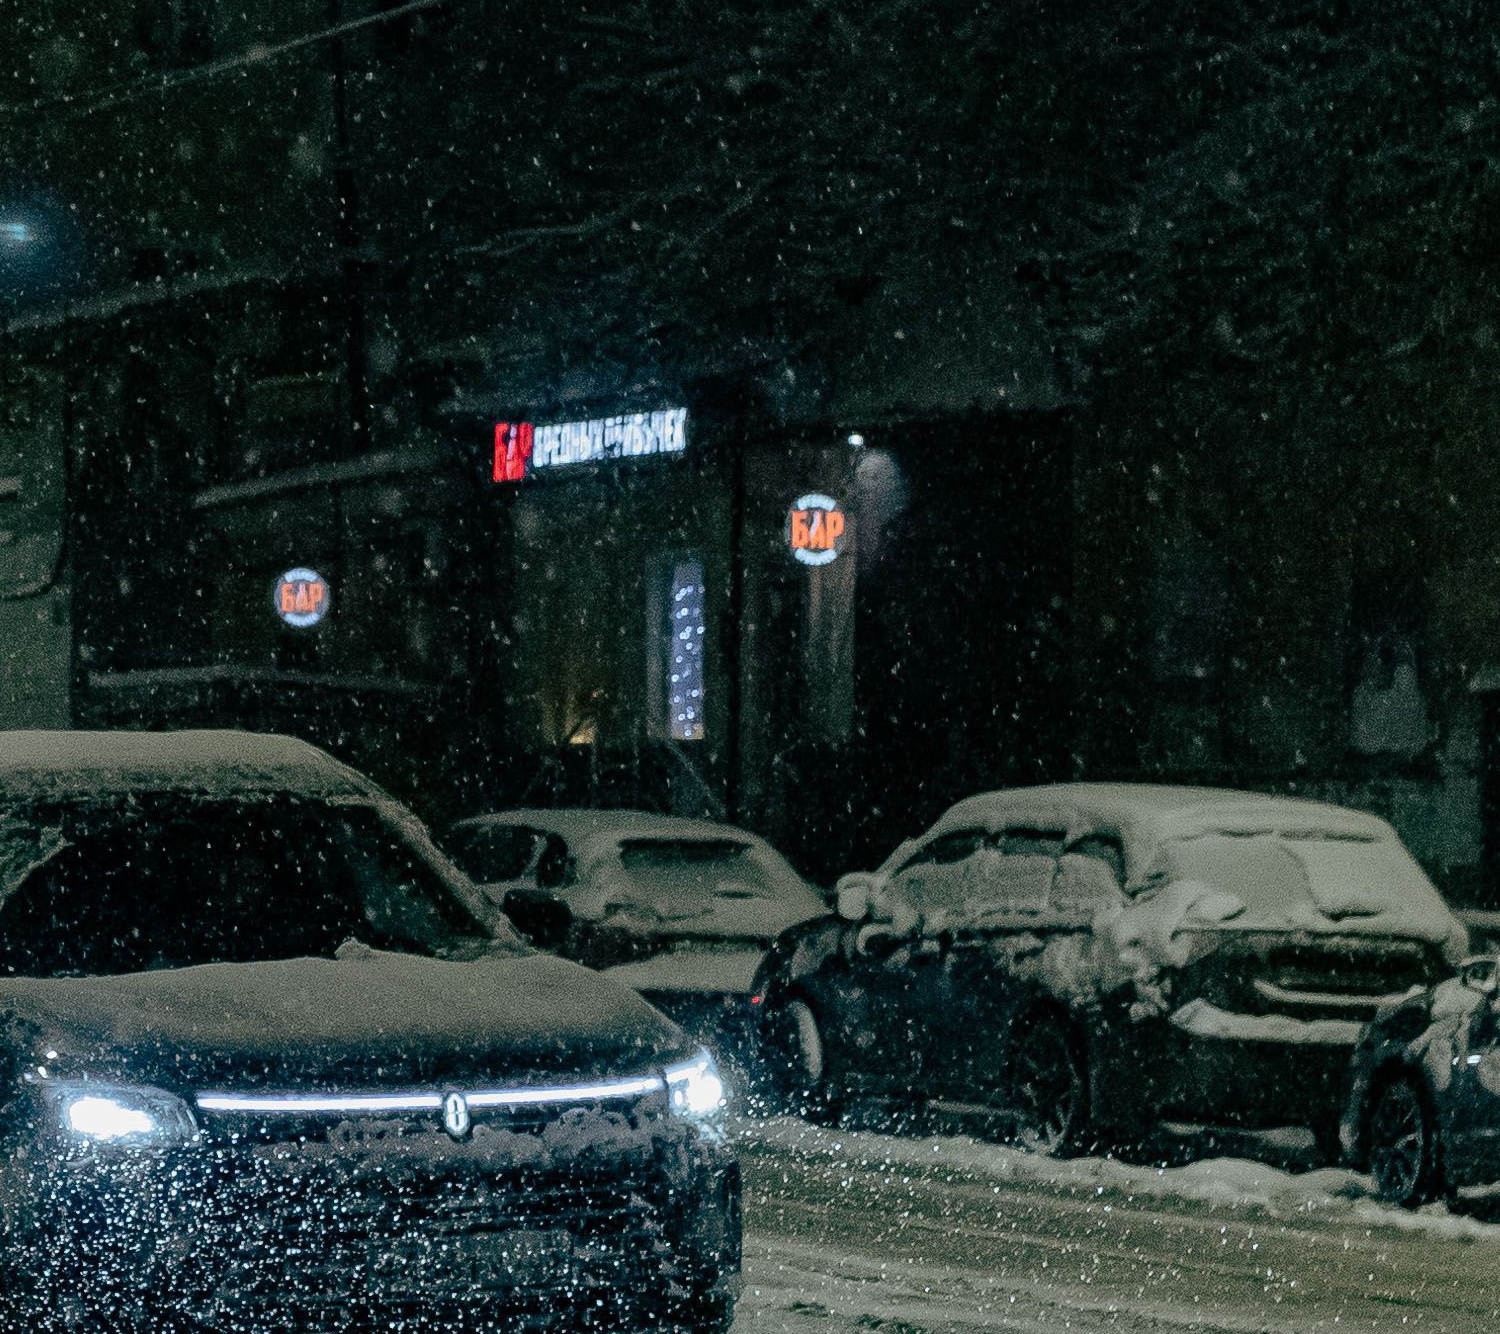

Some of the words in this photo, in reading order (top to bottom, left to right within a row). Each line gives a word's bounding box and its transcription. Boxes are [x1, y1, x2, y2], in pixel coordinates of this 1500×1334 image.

[494, 421, 533, 482] БАР
[792, 510, 844, 549] БАР
[281, 582, 325, 613] БАР
